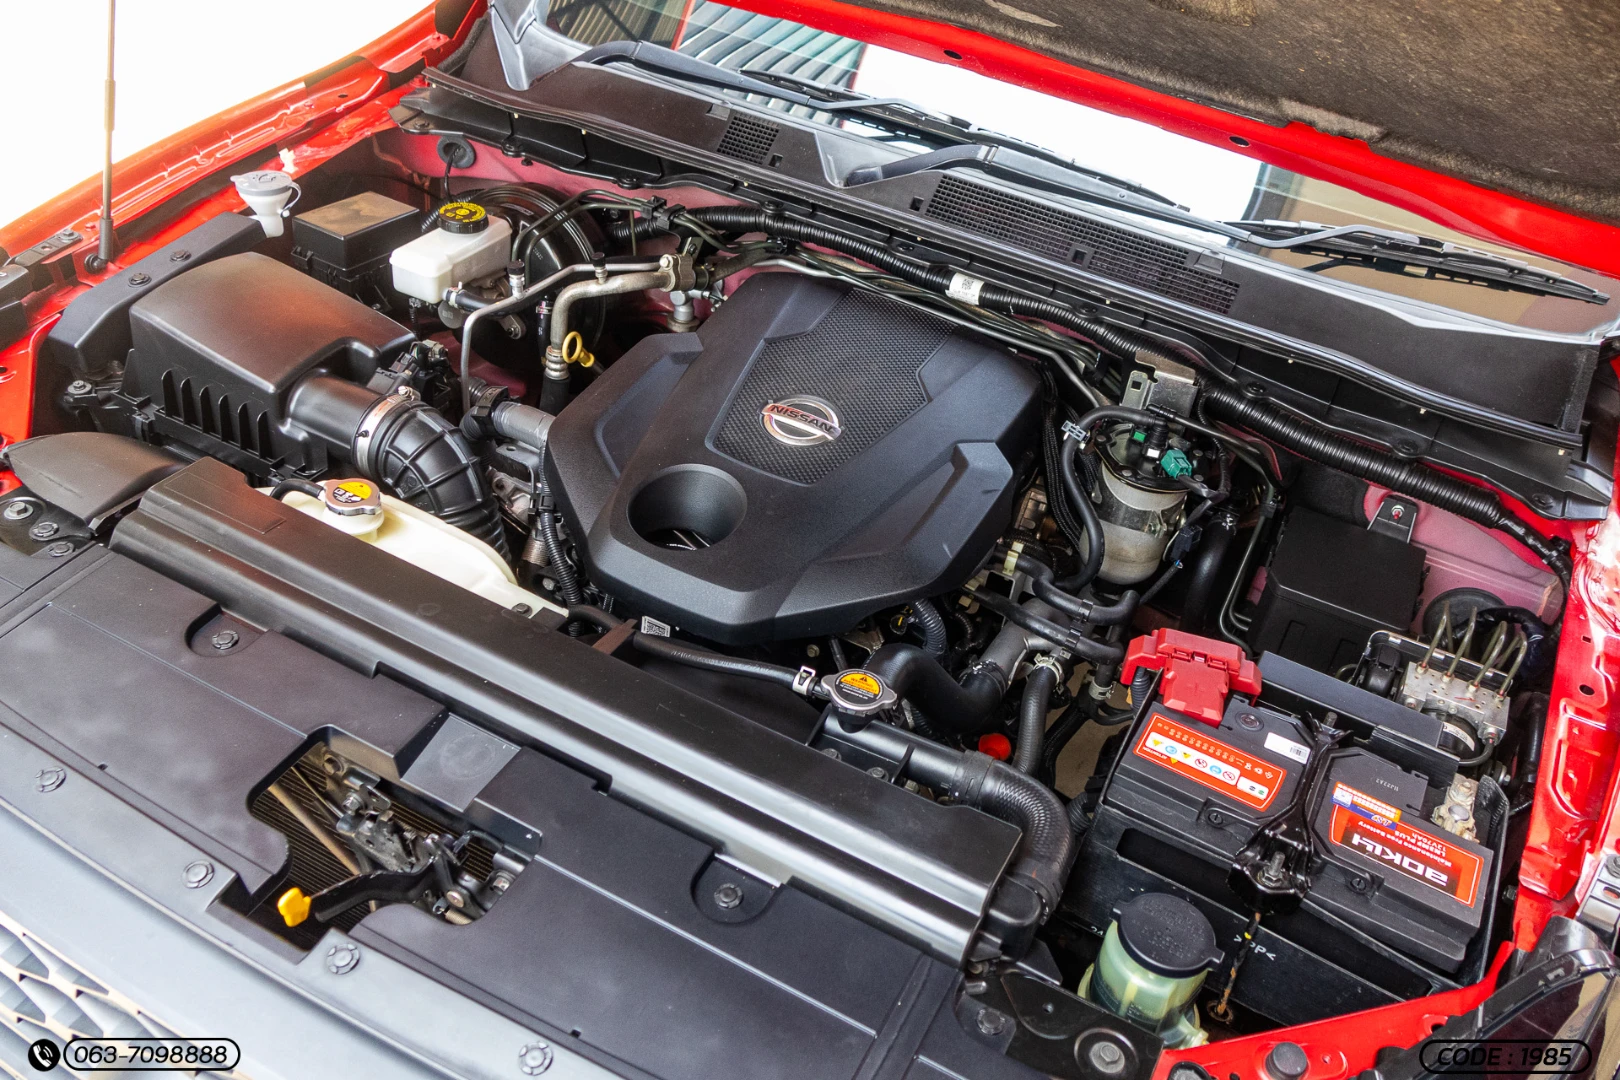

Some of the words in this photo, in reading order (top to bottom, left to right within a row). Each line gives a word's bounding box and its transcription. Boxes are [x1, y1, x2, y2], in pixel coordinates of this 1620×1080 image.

[770, 404, 834, 432] NISSAN
[1357, 820, 1386, 837] Battery
[1394, 830, 1417, 843] PLUS
[1385, 833, 1403, 845] Free
[1411, 832, 1447, 853] 12V70Ah
[1403, 841, 1452, 868] Maintenance
